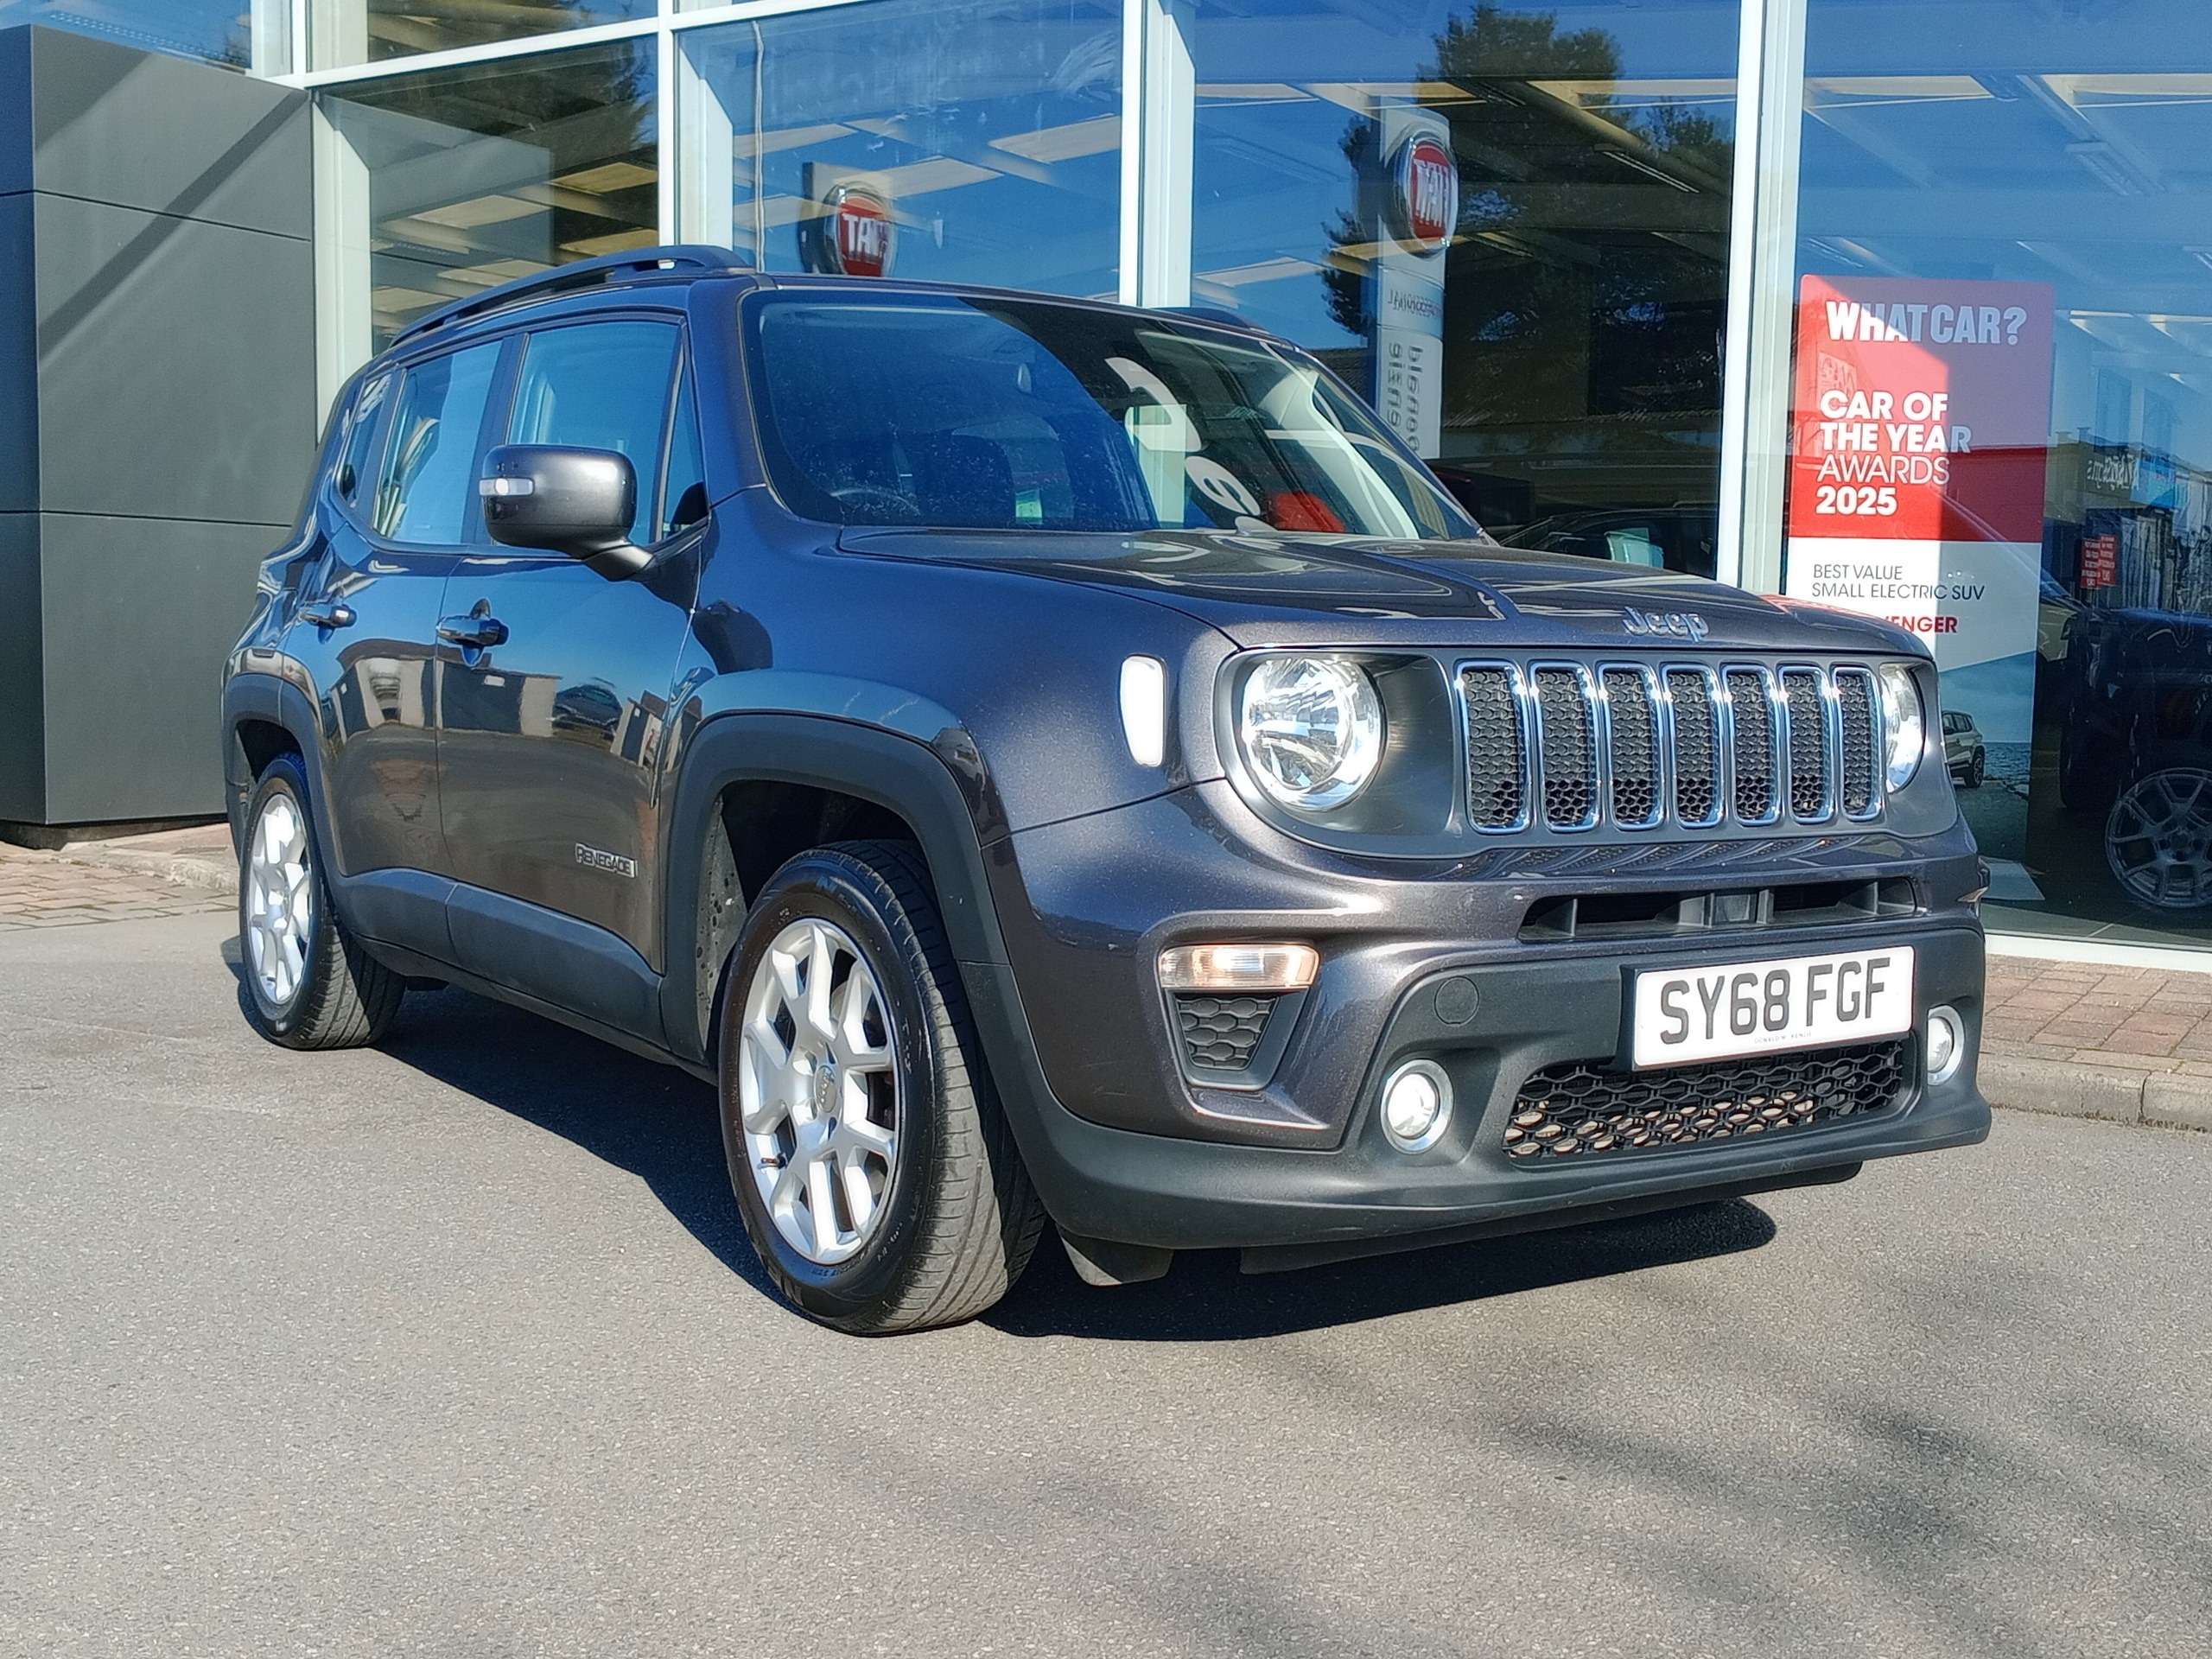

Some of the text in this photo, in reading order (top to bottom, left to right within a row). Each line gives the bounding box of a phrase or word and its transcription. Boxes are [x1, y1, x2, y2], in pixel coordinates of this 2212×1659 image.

[1820, 390, 1948, 421] CAR OF
[1820, 422, 1971, 453] THE YEAR
[1817, 454, 1950, 485] AWARDS
[1816, 486, 1897, 516] 2025
[1814, 564, 1904, 581] BEST VALUE
[1812, 582, 1986, 601] SMALL ELECTRIC SUV
[1622, 605, 1709, 643] Jeep
[575, 842, 636, 879] RENEGADE
[1660, 957, 1891, 1045] SY68 FGF
